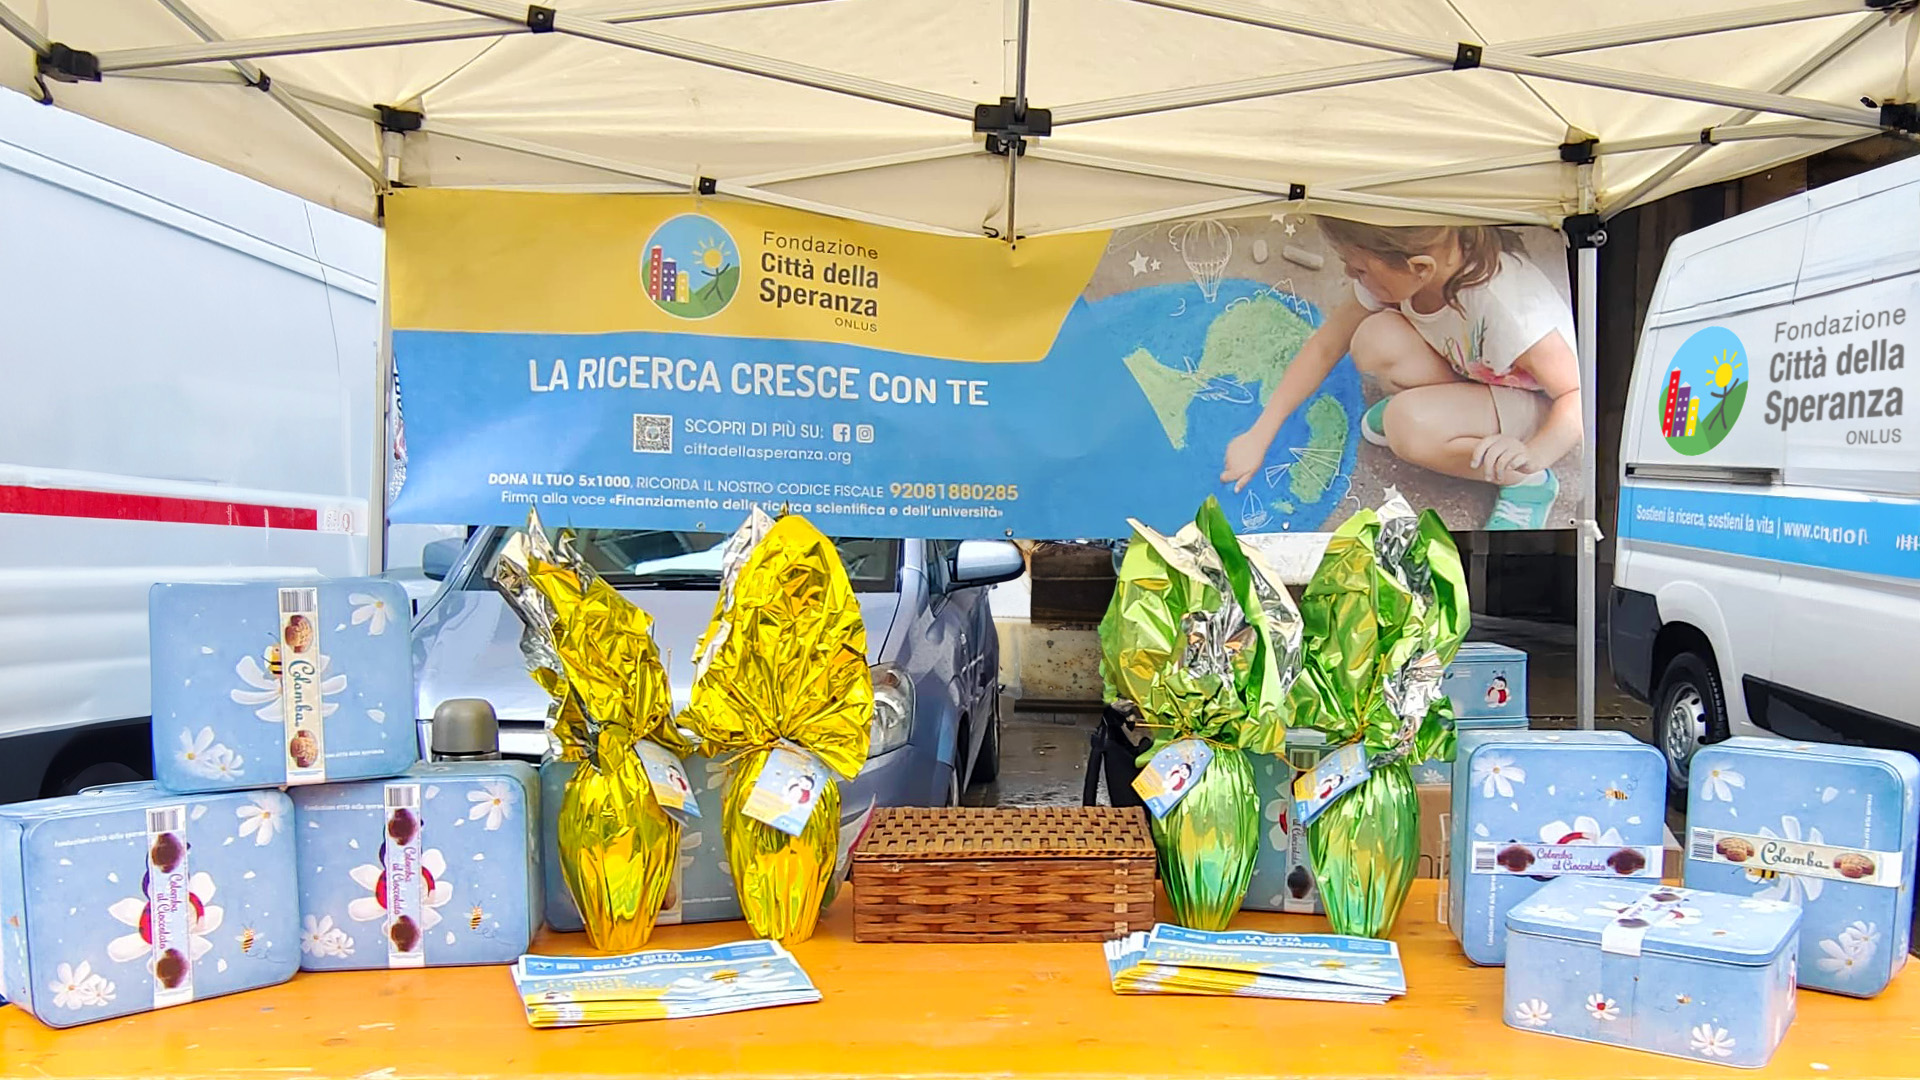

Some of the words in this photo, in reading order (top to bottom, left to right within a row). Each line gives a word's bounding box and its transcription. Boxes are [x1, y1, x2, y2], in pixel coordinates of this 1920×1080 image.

[763, 231, 878, 259] Fondazione
[761, 252, 814, 280] Città
[823, 262, 878, 289] della
[760, 278, 877, 317] Speranza
[834, 317, 878, 332] ONLUS
[1774, 308, 1907, 343] Fondazione
[1769, 346, 1826, 383] Città
[1836, 339, 1905, 376] della
[529, 359, 569, 392] LA
[577, 356, 722, 393] RICERCA
[731, 362, 861, 399] CRESCE
[869, 371, 937, 404] CON
[945, 379, 989, 406] TE
[1764, 387, 1903, 431] Speranza
[684, 418, 746, 436] SCOPRI
[752, 422, 767, 437] DI
[772, 420, 796, 438] PIÙ
[800, 424, 824, 439] SU:
[1846, 428, 1902, 445] ONLUS
[683, 443, 852, 464] cittadellasperanza.org
[488, 473, 528, 486] DONA
[532, 474, 543, 486] IL
[546, 474, 574, 487] TUO
[579, 475, 633, 488] 5x1000,
[636, 477, 699, 491] RICORDA
[704, 480, 714, 492] IL
[717, 480, 774, 494] NOSTRO
[777, 483, 831, 496] CODICE
[834, 484, 884, 498] FISCALE
[890, 482, 1019, 500] 92081880285
[501, 491, 538, 504] Firma
[542, 492, 568, 504] alla
[572, 495, 605, 505] voce
[609, 494, 719, 510] «Finanziamento
[815, 502, 885, 516] scientifica
[889, 507, 898, 516] e
[1636, 504, 1667, 522] Sostieni
[1667, 507, 1675, 523] la
[1675, 508, 1706, 529] ricerca,
[1708, 512, 1744, 531] sostieni
[1745, 513, 1754, 532] la
[1756, 515, 1774, 534] vita
[288, 660, 316, 725] Colomba
[1537, 848, 1573, 860] Colomba
[1552, 860, 1561, 871] al
[1563, 859, 1606, 872] Cioccolato
[1761, 842, 1825, 869] Colomba
